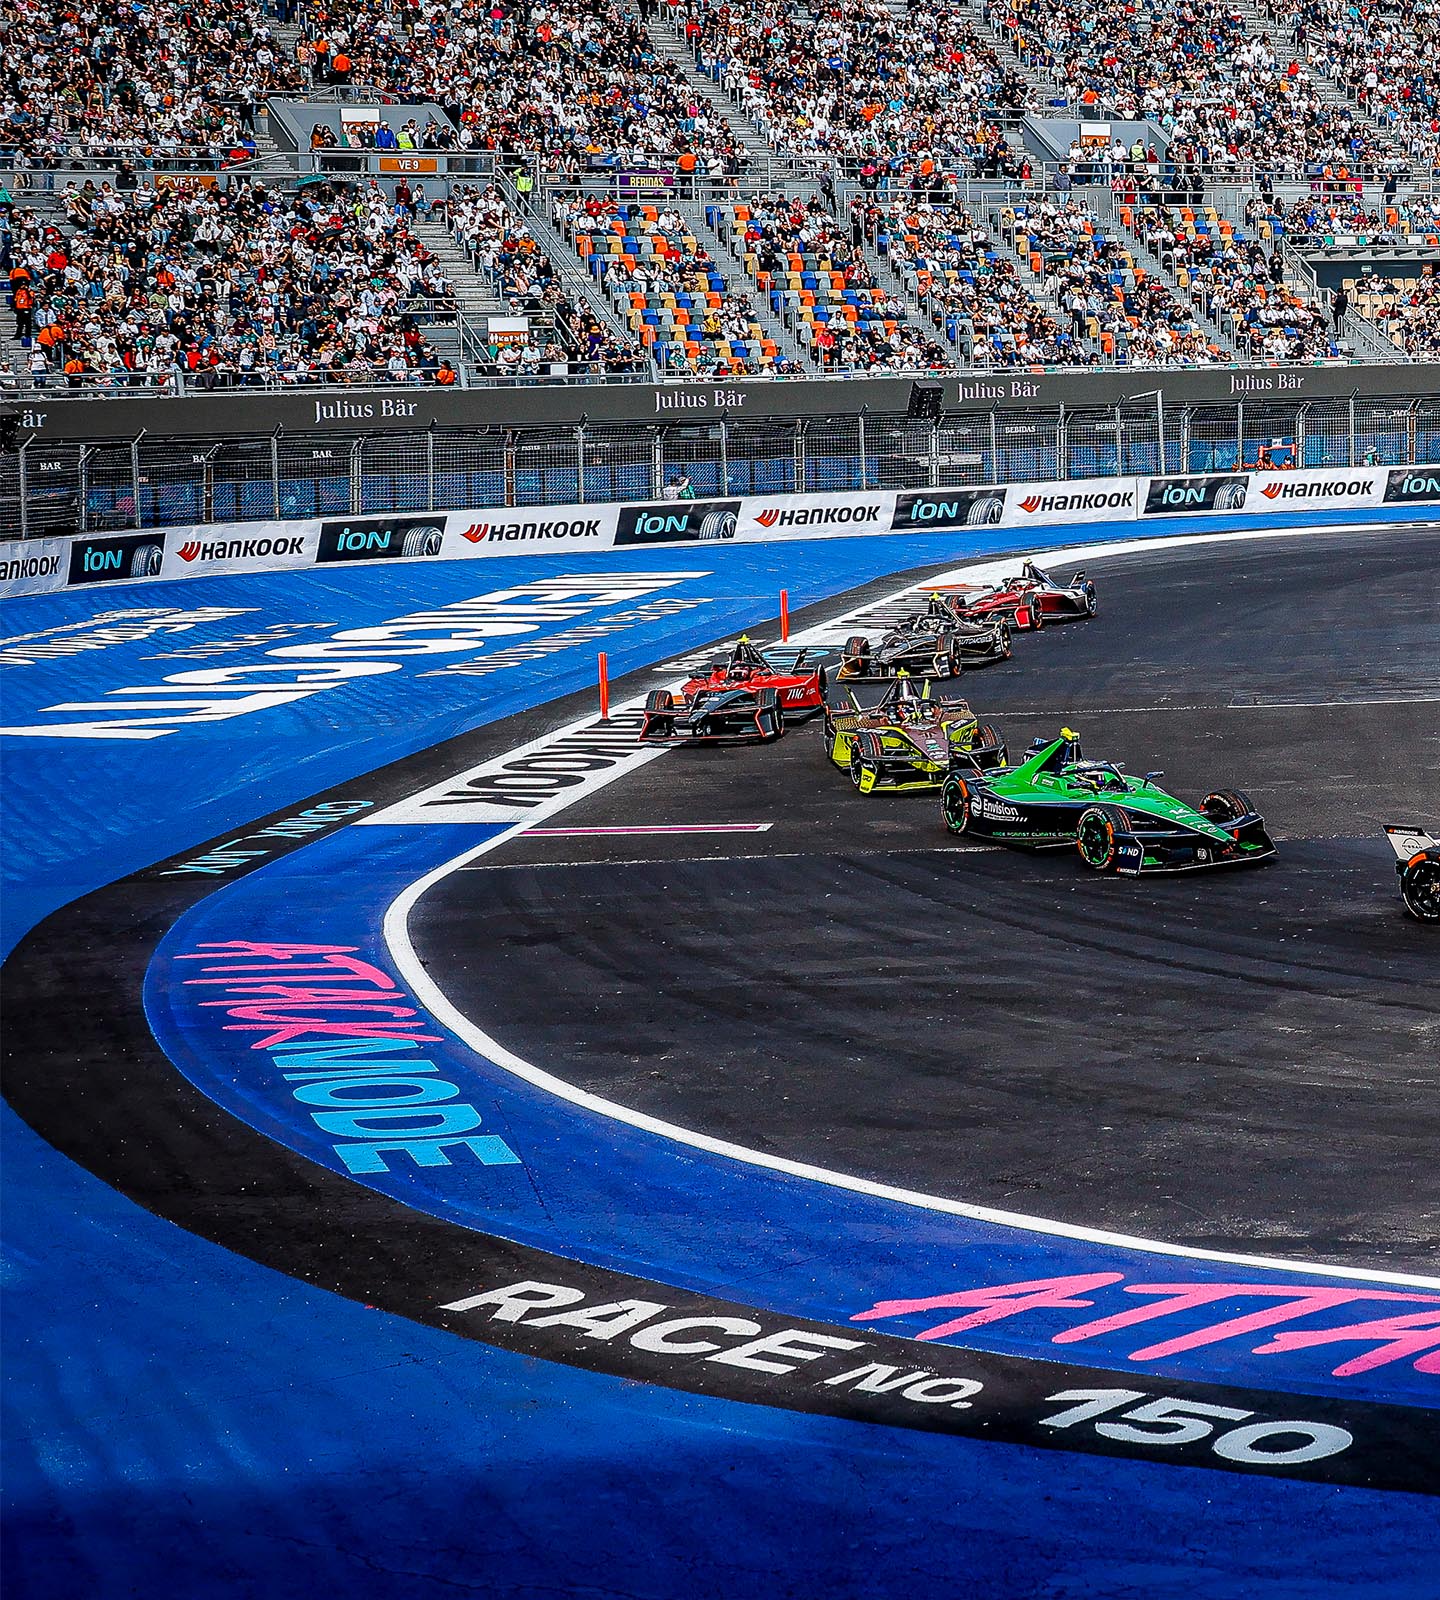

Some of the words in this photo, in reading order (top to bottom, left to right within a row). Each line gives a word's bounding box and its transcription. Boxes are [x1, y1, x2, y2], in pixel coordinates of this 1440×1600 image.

[957, 381, 1006, 403] Julius
[1011, 379, 1040, 398] Bär
[1230, 374, 1271, 394] Julius
[1276, 372, 1304, 390] Bär
[314, 400, 375, 424] Julius
[381, 398, 418, 418] Bär
[654, 391, 708, 413] Julius
[714, 388, 747, 409] Bär
[22, 410, 48, 428] är
[1005, 425, 1036, 434] BEBIDAS
[40, 461, 62, 471] BAR
[192, 454, 206, 464] BA
[312, 450, 333, 459] BAR
[264, 571, 715, 658] MEXICO
[0, 660, 402, 740] CITY
[983, 798, 1019, 816] Envision
[173, 940, 445, 1050] ATTACK
[266, 1036, 522, 1175] MODE
[438, 1280, 867, 1374] RACE
[823, 1361, 985, 1410] NO.
[1038, 1388, 1354, 1465] 150
